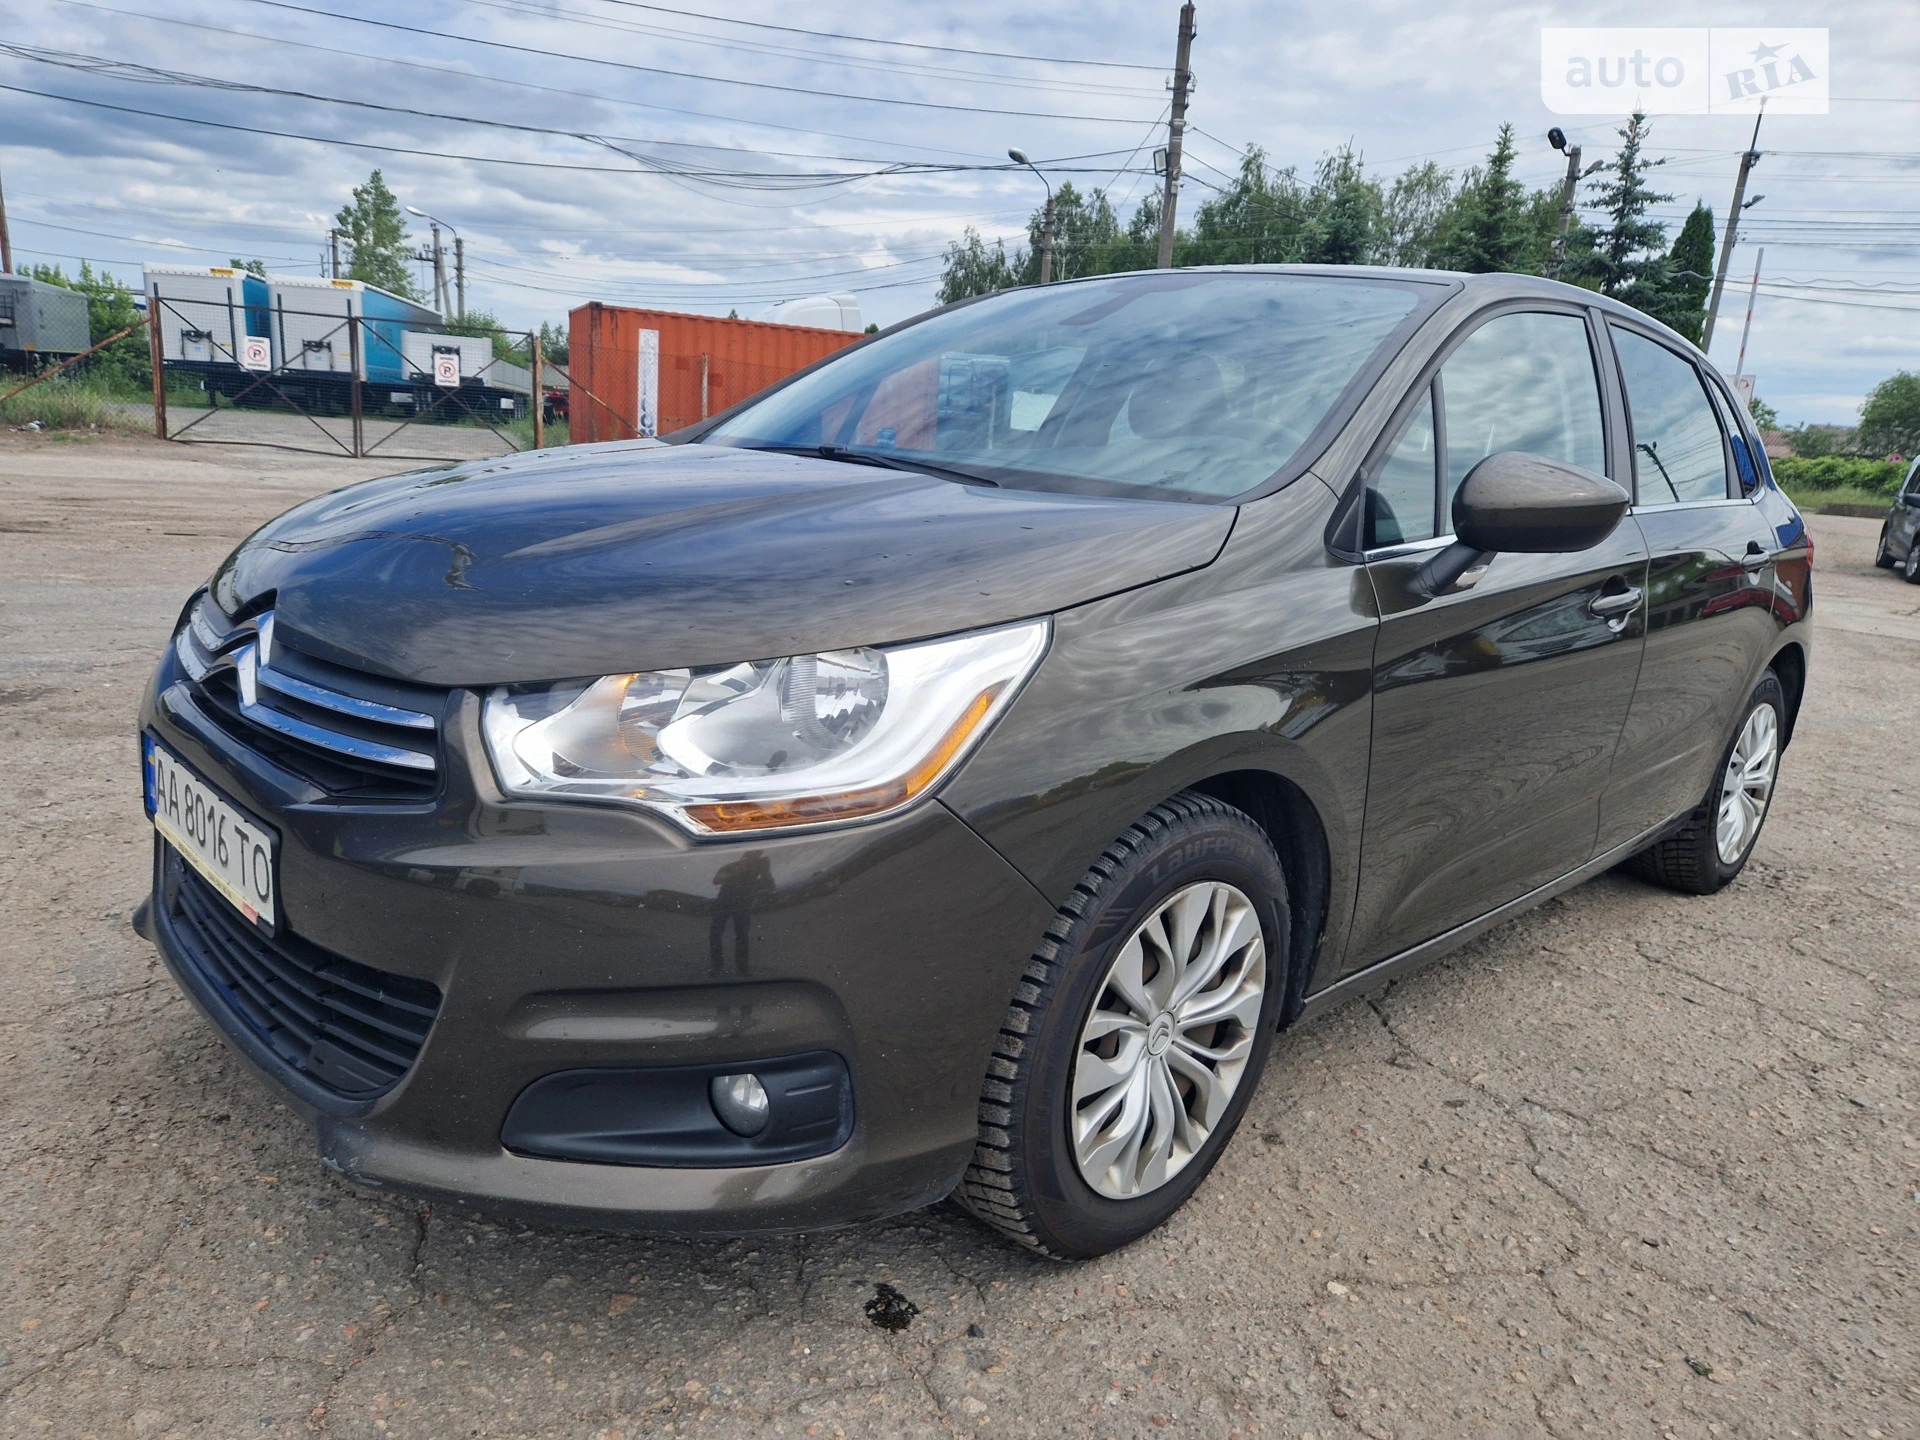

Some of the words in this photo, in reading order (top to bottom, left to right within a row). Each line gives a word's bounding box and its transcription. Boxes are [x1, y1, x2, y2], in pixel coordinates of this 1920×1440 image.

[157, 758, 181, 826] AA
[184, 783, 229, 868] 8016
[234, 824, 270, 904] TO
